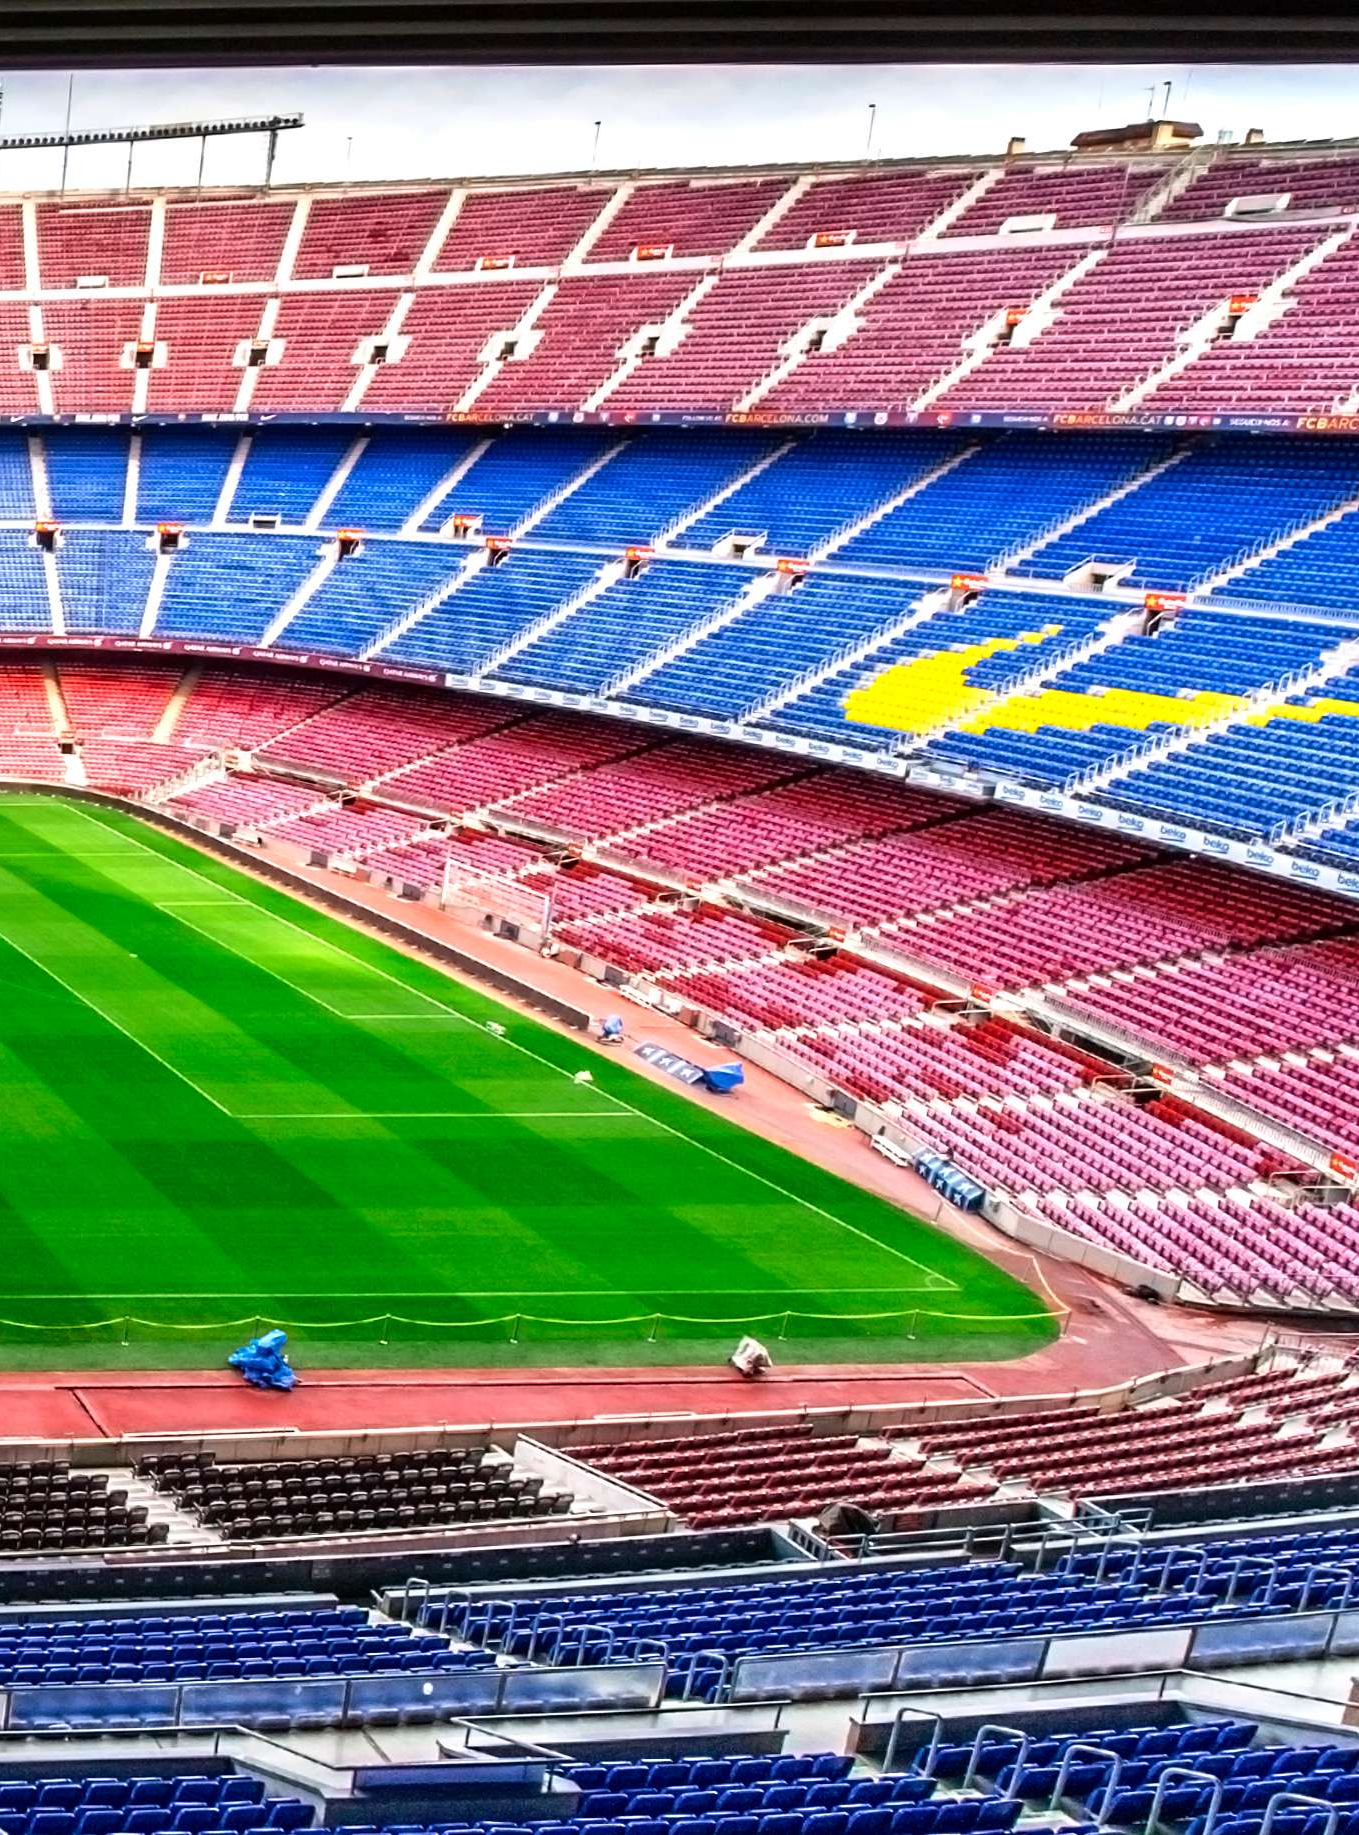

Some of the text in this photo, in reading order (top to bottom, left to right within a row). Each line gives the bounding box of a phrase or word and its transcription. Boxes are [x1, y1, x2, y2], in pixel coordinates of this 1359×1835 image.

[725, 413, 829, 424] FCBARCELONA.COM
[1052, 413, 1163, 425] FCBARCELONA.CAT
[1160, 825, 1186, 839] beko
[1203, 836, 1230, 851] beko
[1247, 848, 1274, 864] beko
[1291, 861, 1320, 877] beko
